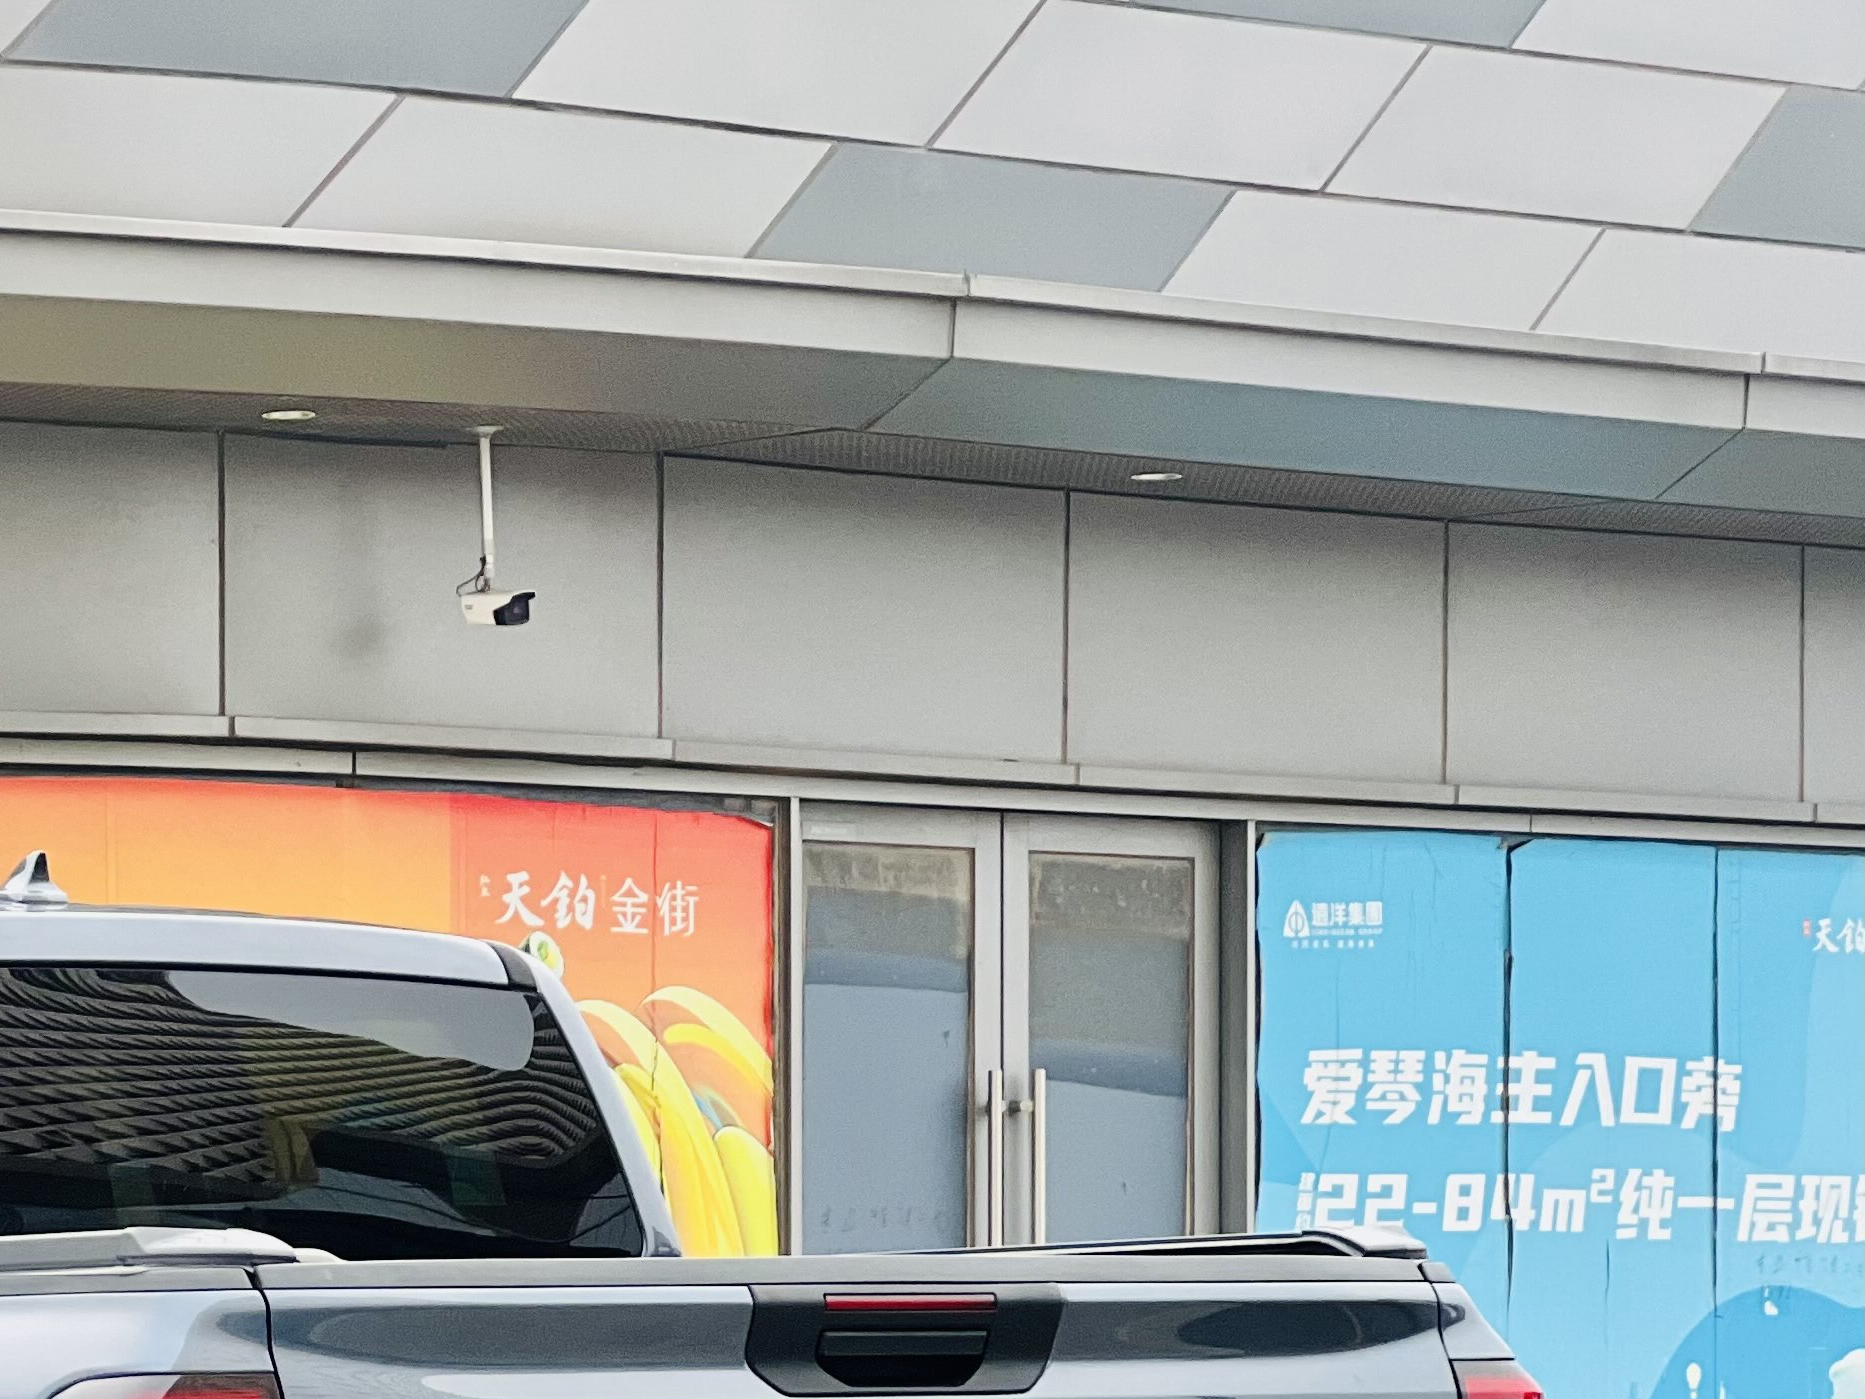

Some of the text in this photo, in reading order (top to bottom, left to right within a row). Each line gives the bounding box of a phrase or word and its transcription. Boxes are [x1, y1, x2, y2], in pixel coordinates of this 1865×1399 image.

[1299, 1047, 1743, 1132] 爱琴海主入口旁
